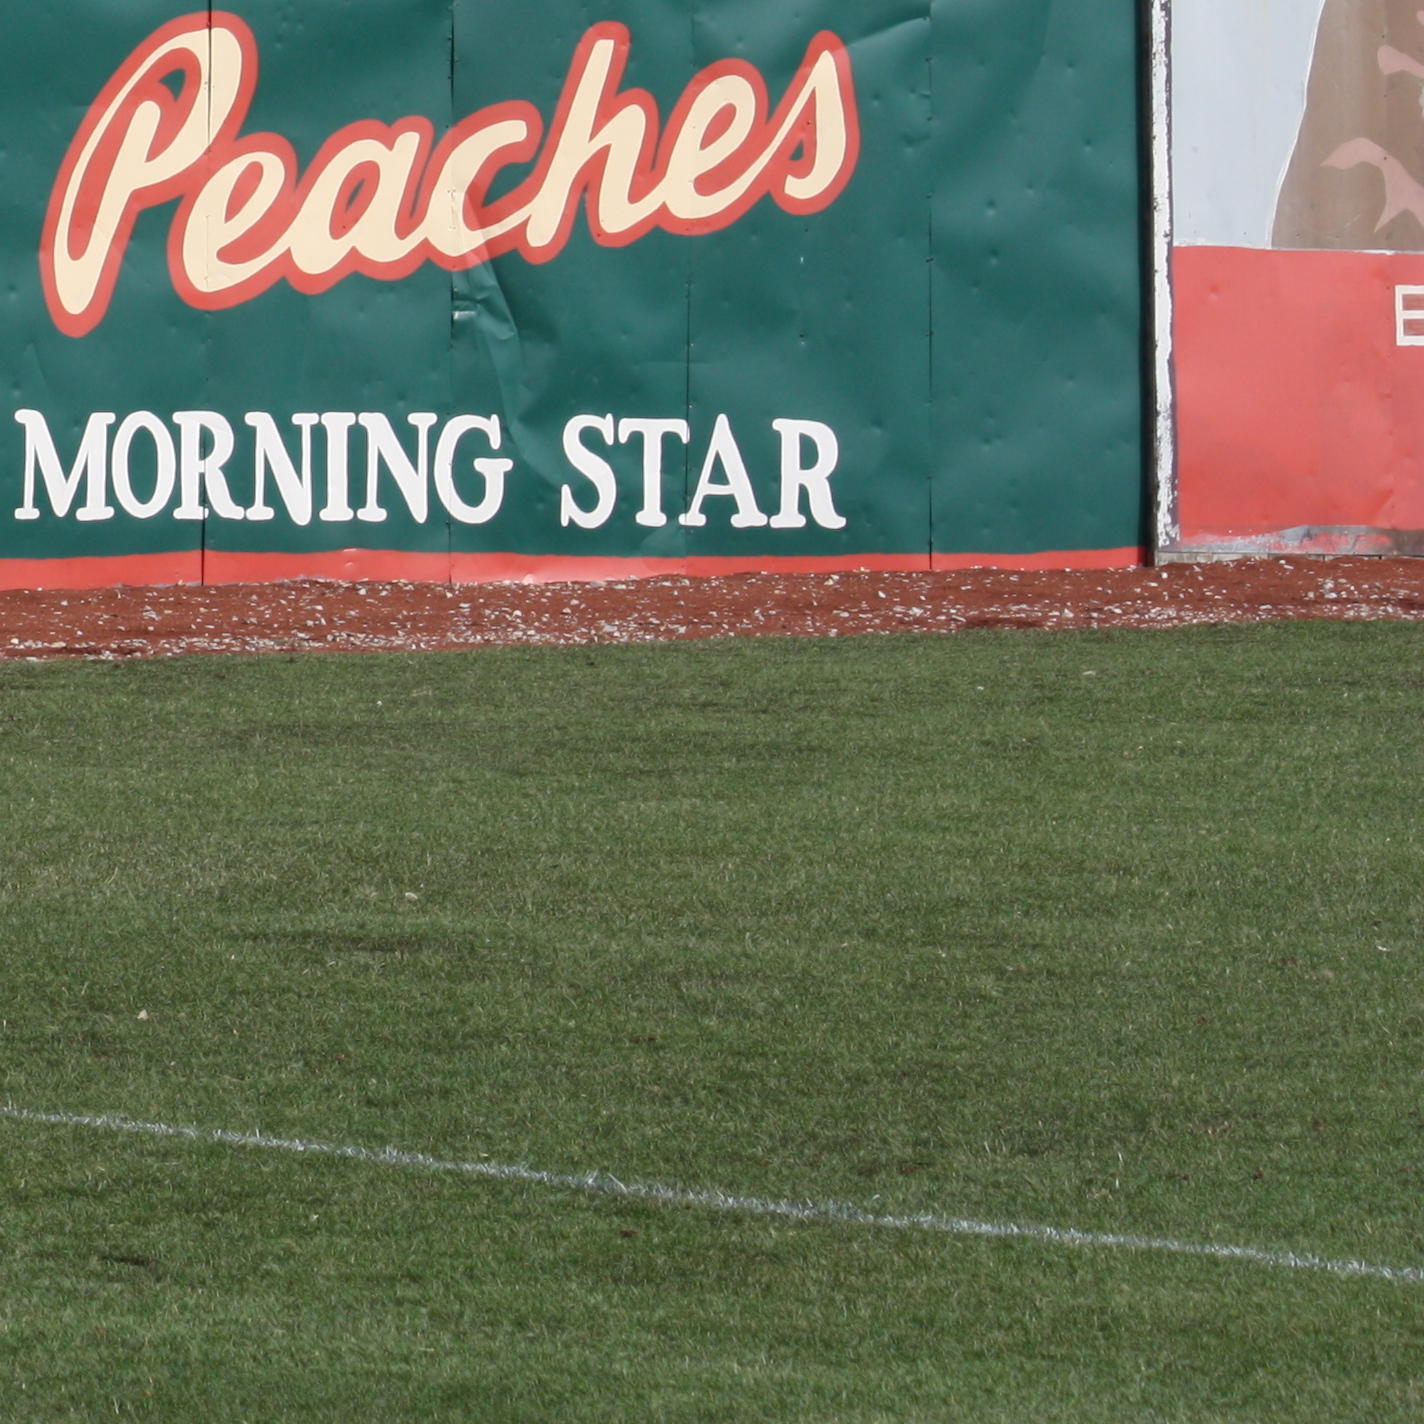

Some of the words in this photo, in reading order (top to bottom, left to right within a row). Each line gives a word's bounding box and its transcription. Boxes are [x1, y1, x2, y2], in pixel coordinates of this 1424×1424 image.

[40, 11, 860, 337] Peaches
[15, 409, 513, 525] MORNING
[561, 414, 846, 529] STAR
